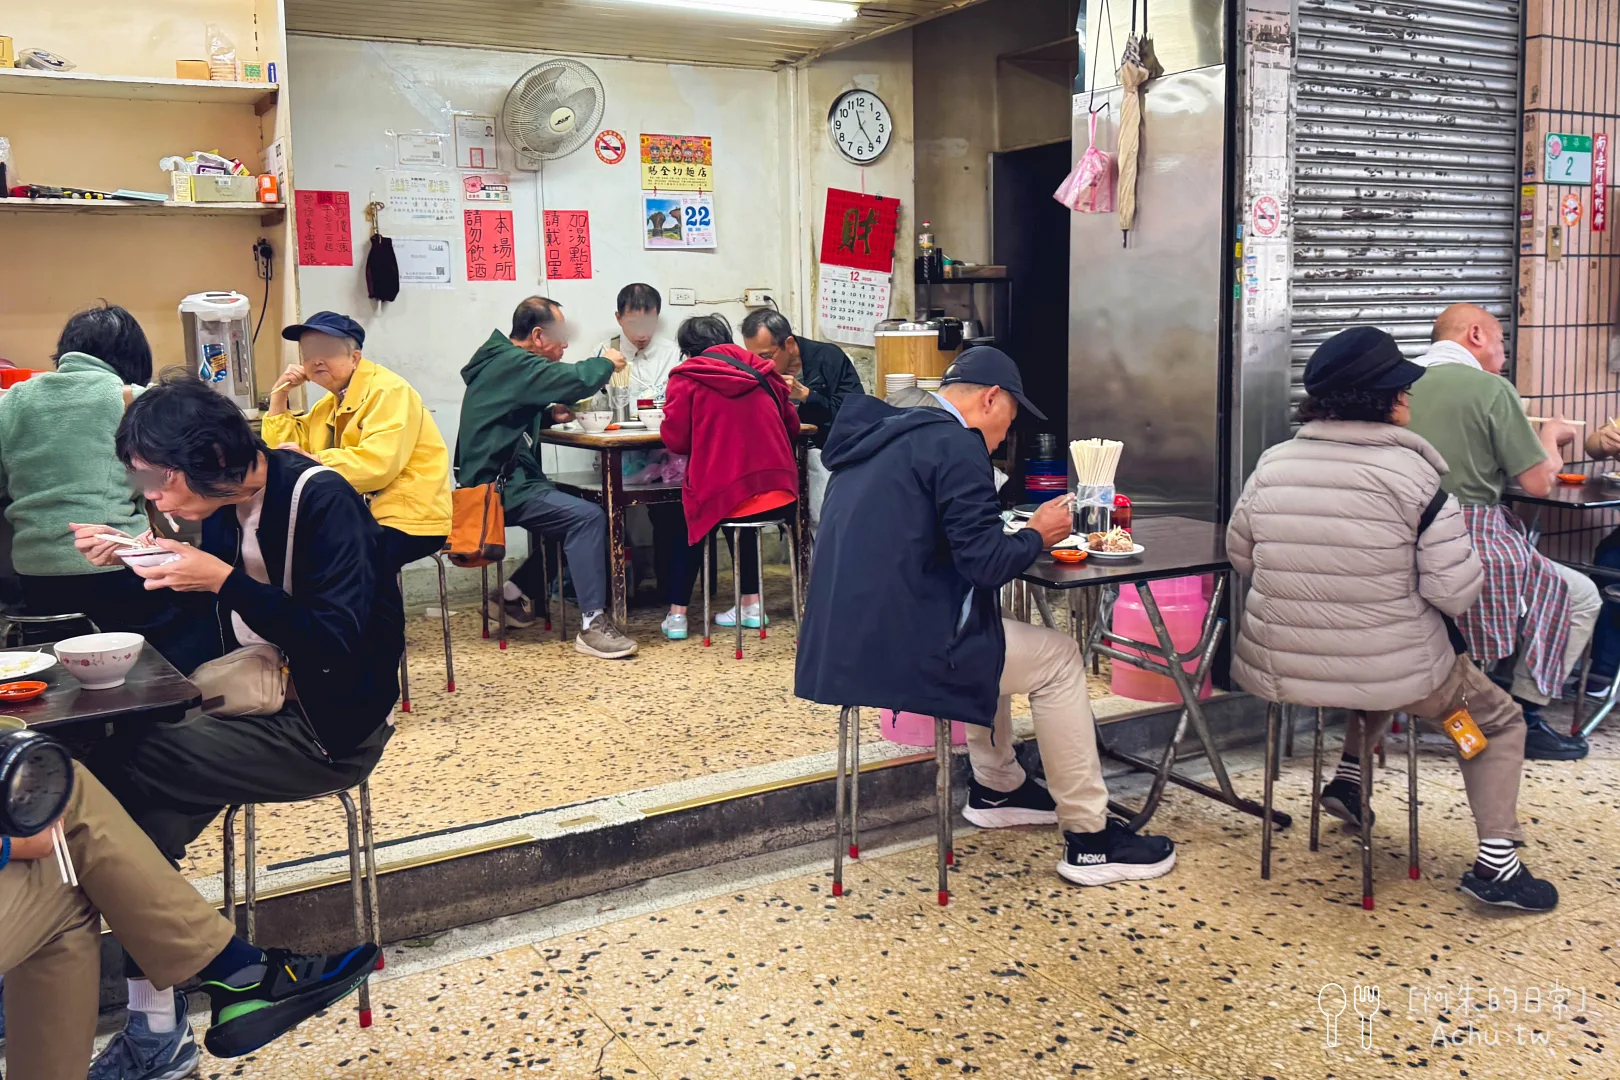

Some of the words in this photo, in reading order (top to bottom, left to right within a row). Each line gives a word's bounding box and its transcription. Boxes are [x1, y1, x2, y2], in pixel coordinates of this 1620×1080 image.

[847, 100, 854, 110] 11
[856, 97, 865, 107] 12
[870, 102, 873, 111] 1
[839, 108, 848, 118] 10
[875, 111, 881, 120] 2
[835, 120, 841, 130] 9
[879, 124, 884, 132] 3
[839, 132, 845, 142] 8
[875, 135, 881, 144] 4
[848, 142, 853, 151] 7
[857, 146, 863, 155] 6
[868, 142, 874, 152] 5
[1565, 156, 1574, 176] 2
[685, 206, 710, 226] 22
[464, 210, 486, 278] 請勿飲酒
[493, 211, 514, 280] 本場所
[544, 210, 562, 279] 請戴口罩
[567, 214, 590, 278] 加湯點菜
[850, 271, 860, 281] 12
[1077, 853, 1107, 864] HOKA
